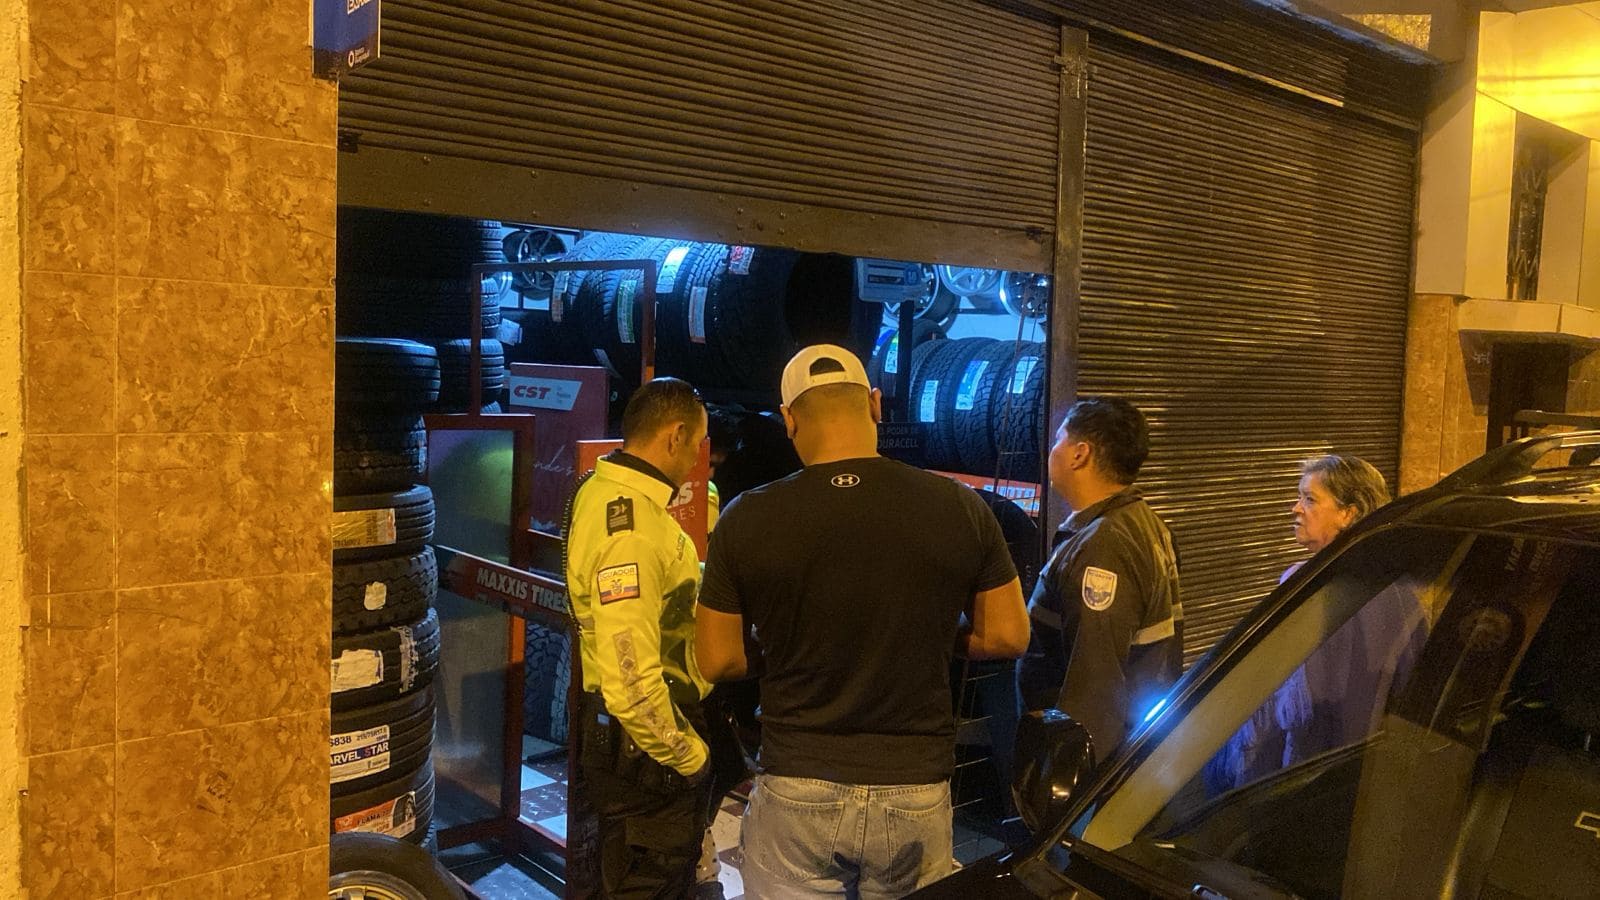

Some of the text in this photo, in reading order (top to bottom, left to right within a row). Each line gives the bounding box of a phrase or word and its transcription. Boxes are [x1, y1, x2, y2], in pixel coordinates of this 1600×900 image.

[513, 385, 551, 400] CST
[600, 567, 635, 578] ECUADOR
[477, 567, 568, 614] MAXXIS TIRES
[364, 741, 389, 757] STAR
